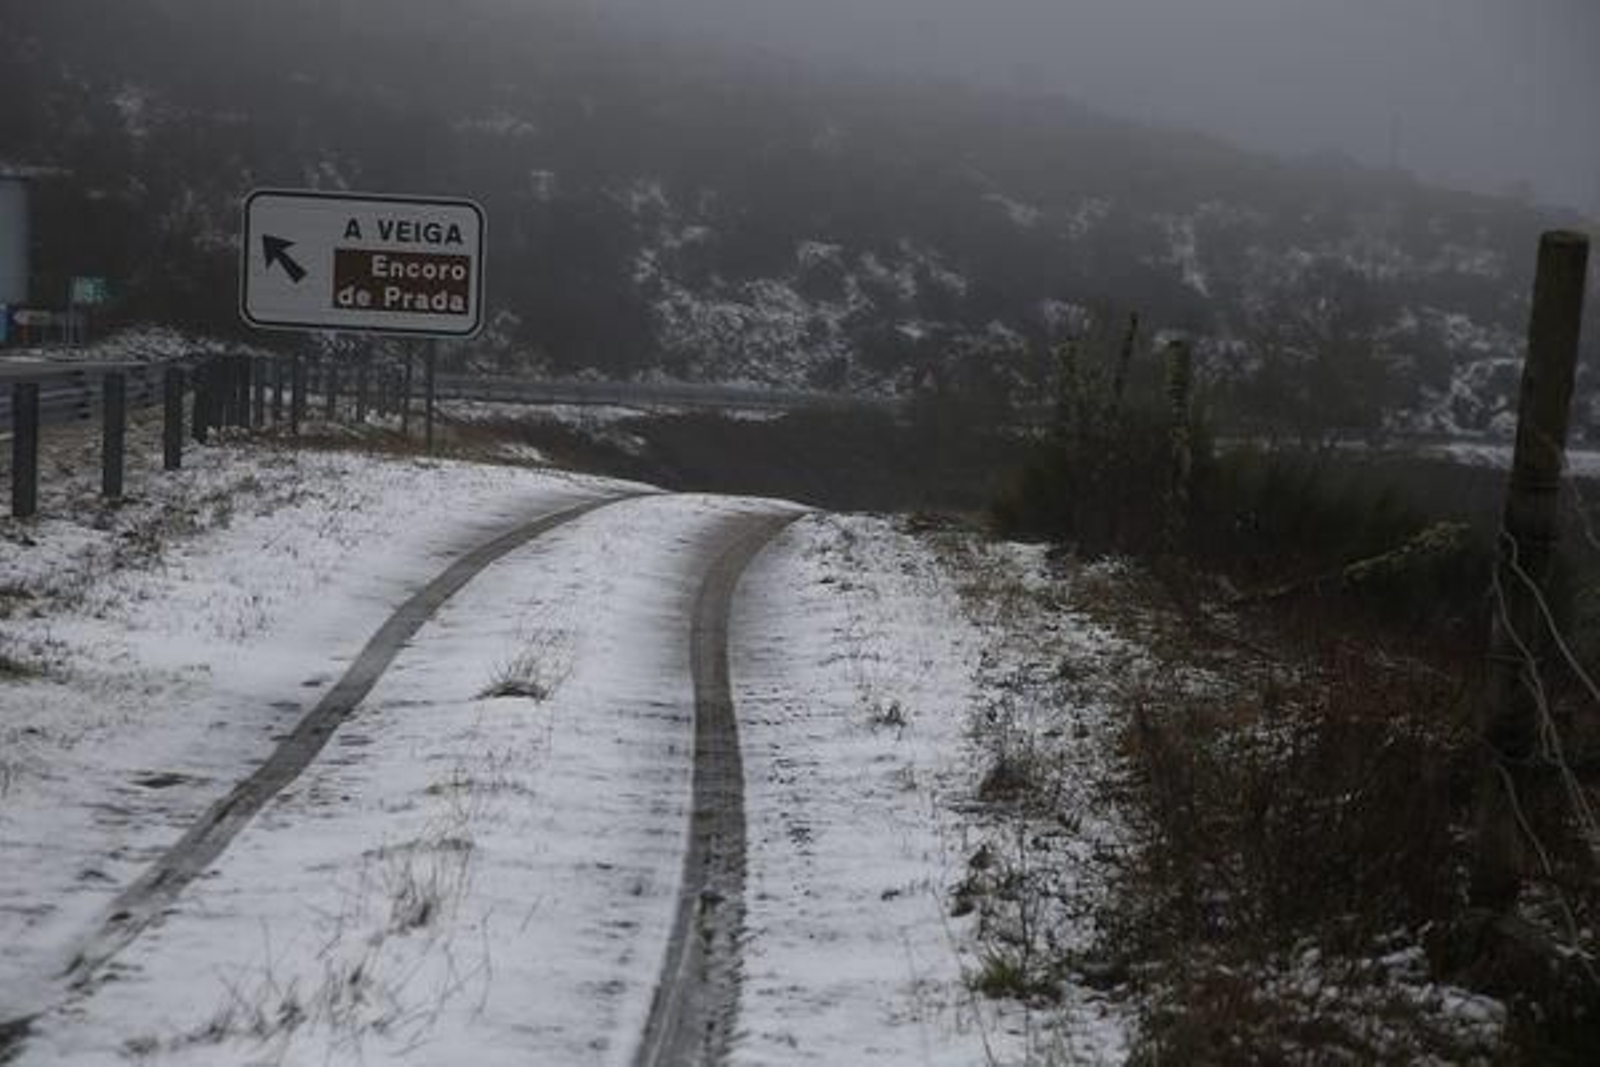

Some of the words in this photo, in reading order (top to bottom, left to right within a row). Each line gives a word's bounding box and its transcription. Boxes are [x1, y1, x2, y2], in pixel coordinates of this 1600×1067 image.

[343, 218, 362, 239] A
[377, 219, 464, 245] VEIGA
[372, 255, 466, 280] Encoro
[338, 286, 371, 306] de
[384, 287, 464, 311] Prada
